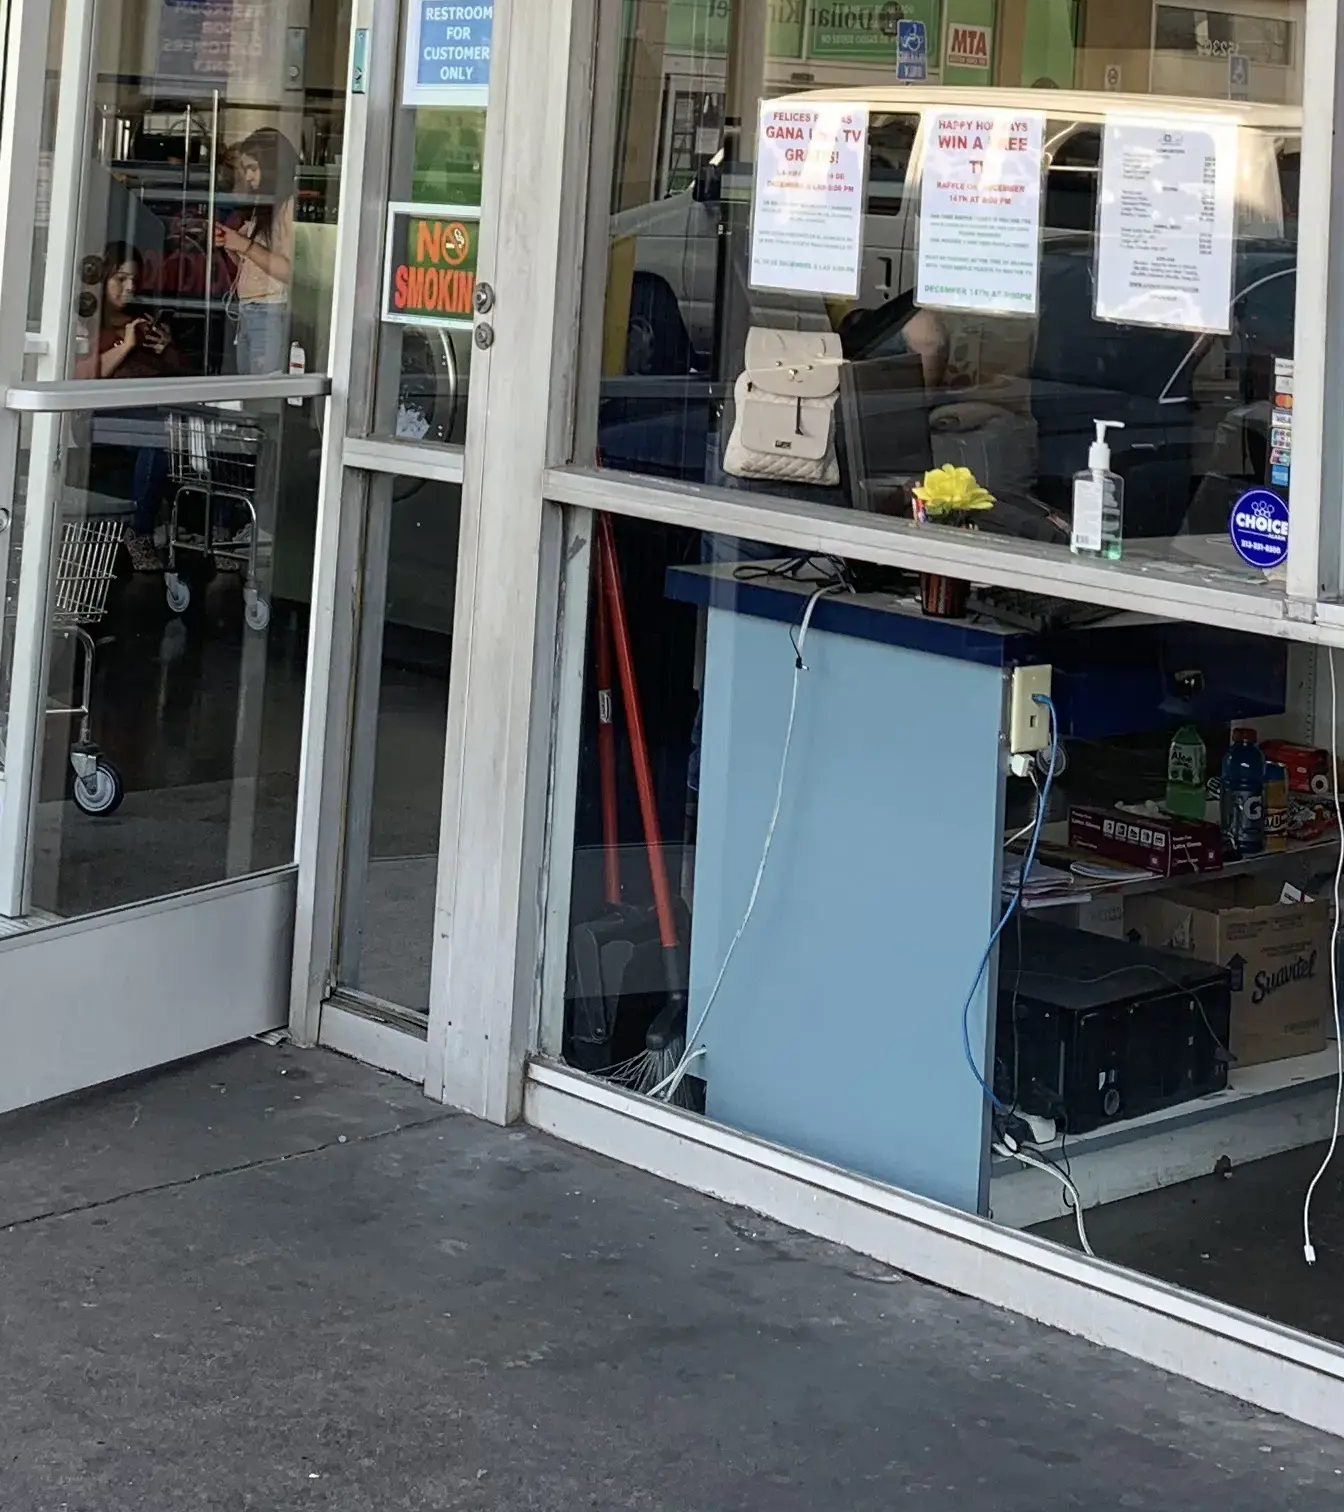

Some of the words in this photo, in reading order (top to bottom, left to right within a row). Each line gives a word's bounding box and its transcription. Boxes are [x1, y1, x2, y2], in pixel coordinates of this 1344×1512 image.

[425, 6, 493, 21] RESTROOM
[446, 25, 471, 40] FOR
[951, 27, 989, 57] MTA
[423, 45, 491, 62] CUSTOMER
[439, 65, 474, 81] ONLY
[773, 111, 811, 123] FELICES
[938, 119, 973, 131] HAPPY
[766, 125, 805, 140] GANA
[842, 129, 862, 144] TV
[938, 134, 968, 149] WIN
[972, 136, 983, 149] A
[393, 263, 474, 313] SMOKIN
[1235, 511, 1288, 536] CHOICE
[1251, 949, 1317, 1005] Suavitel
